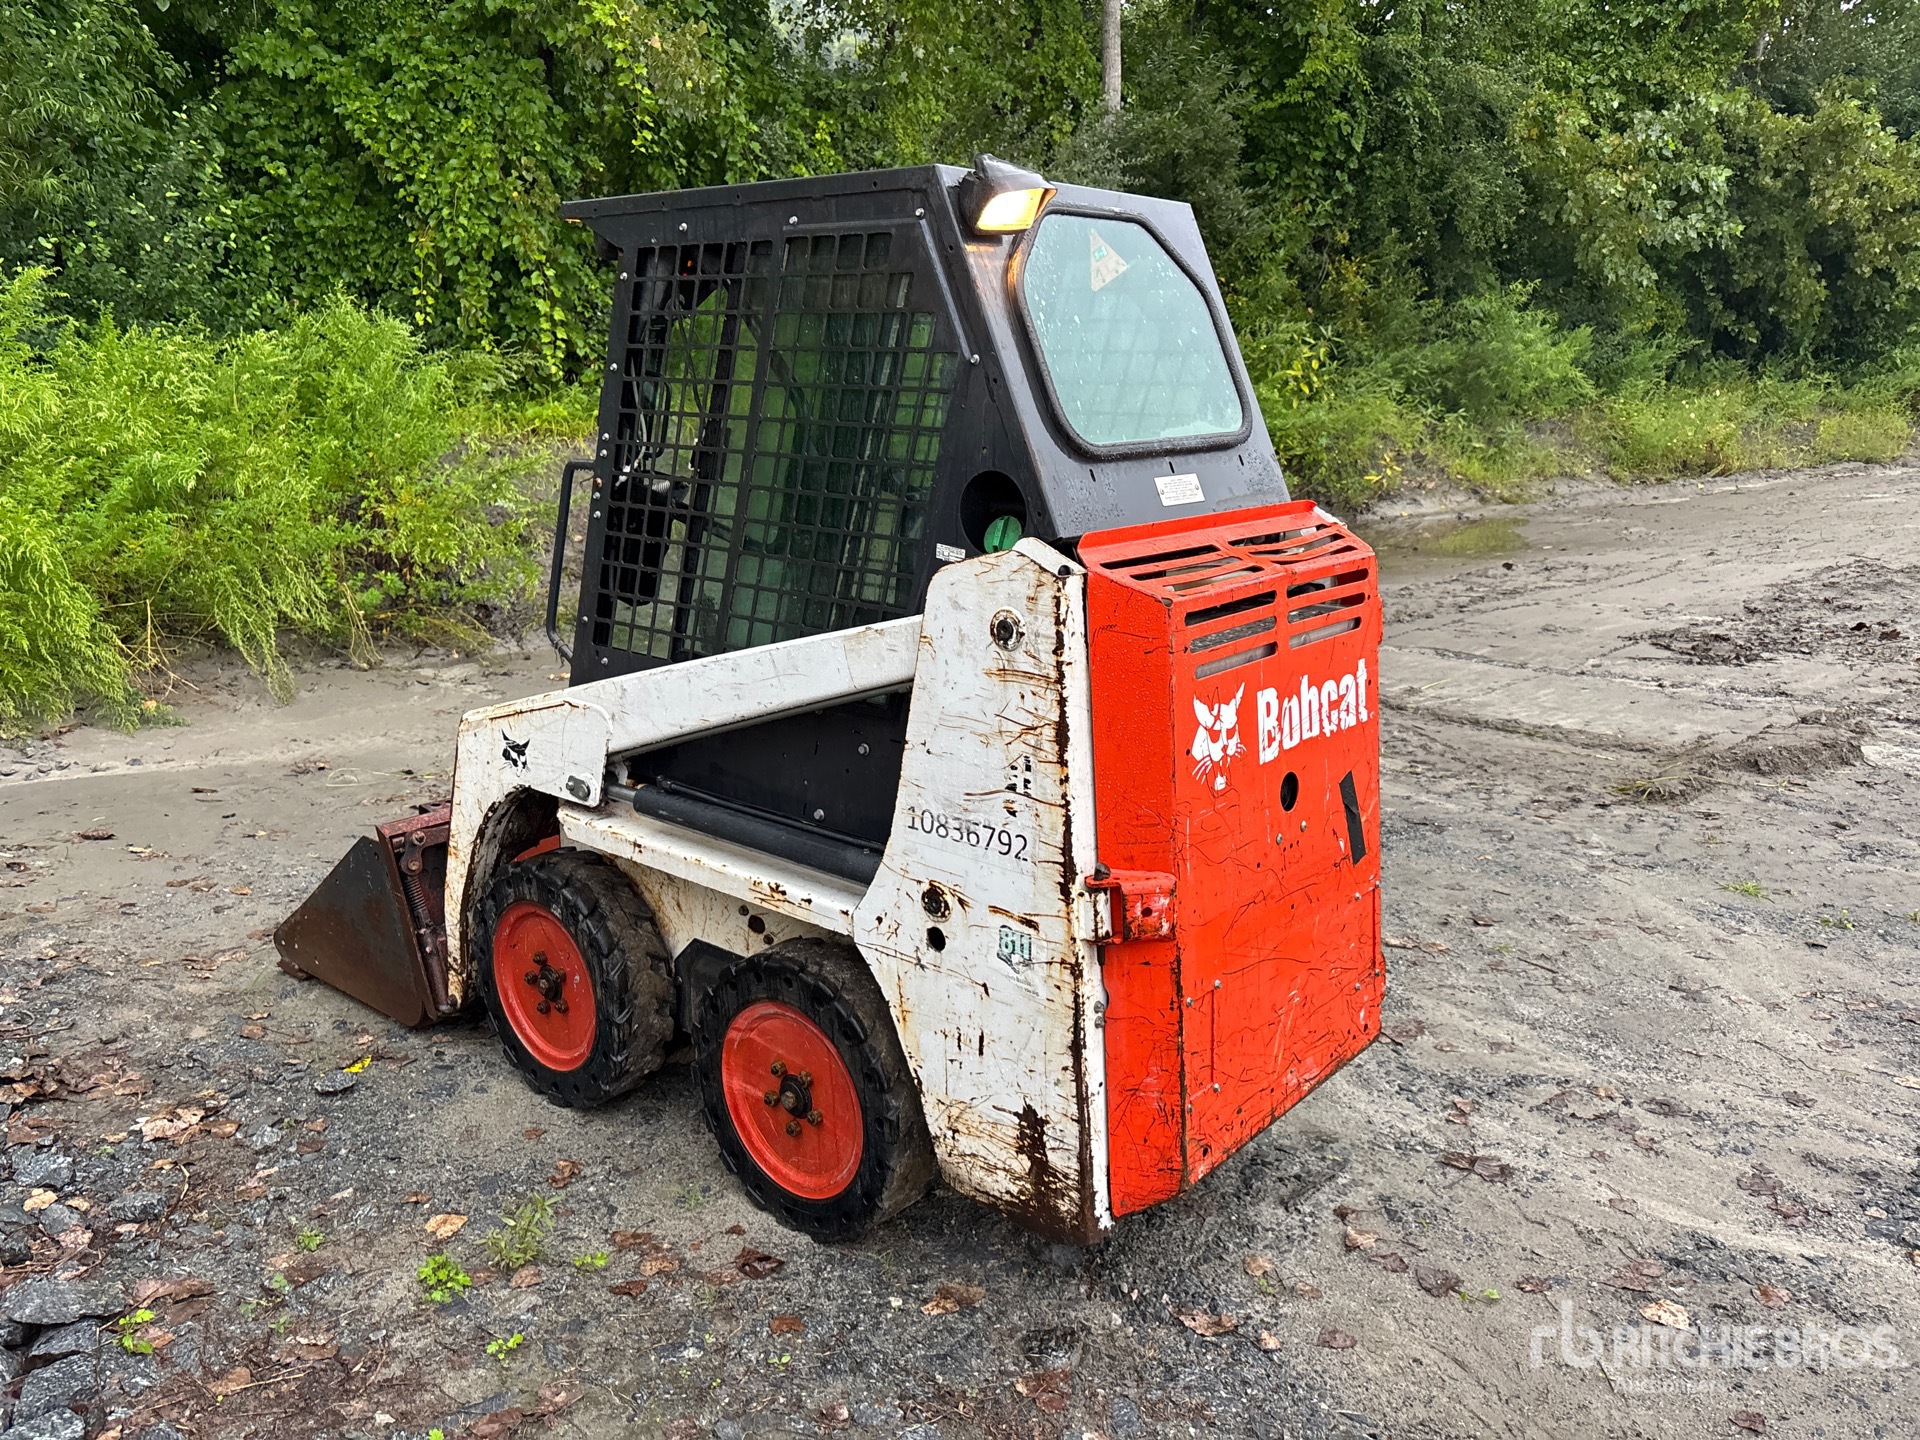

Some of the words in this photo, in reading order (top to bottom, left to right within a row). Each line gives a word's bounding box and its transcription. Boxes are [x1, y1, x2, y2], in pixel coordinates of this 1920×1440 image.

[1257, 658, 1368, 765] Bobcat
[907, 806, 1028, 862] 10836792
[998, 925, 1032, 960] 811
